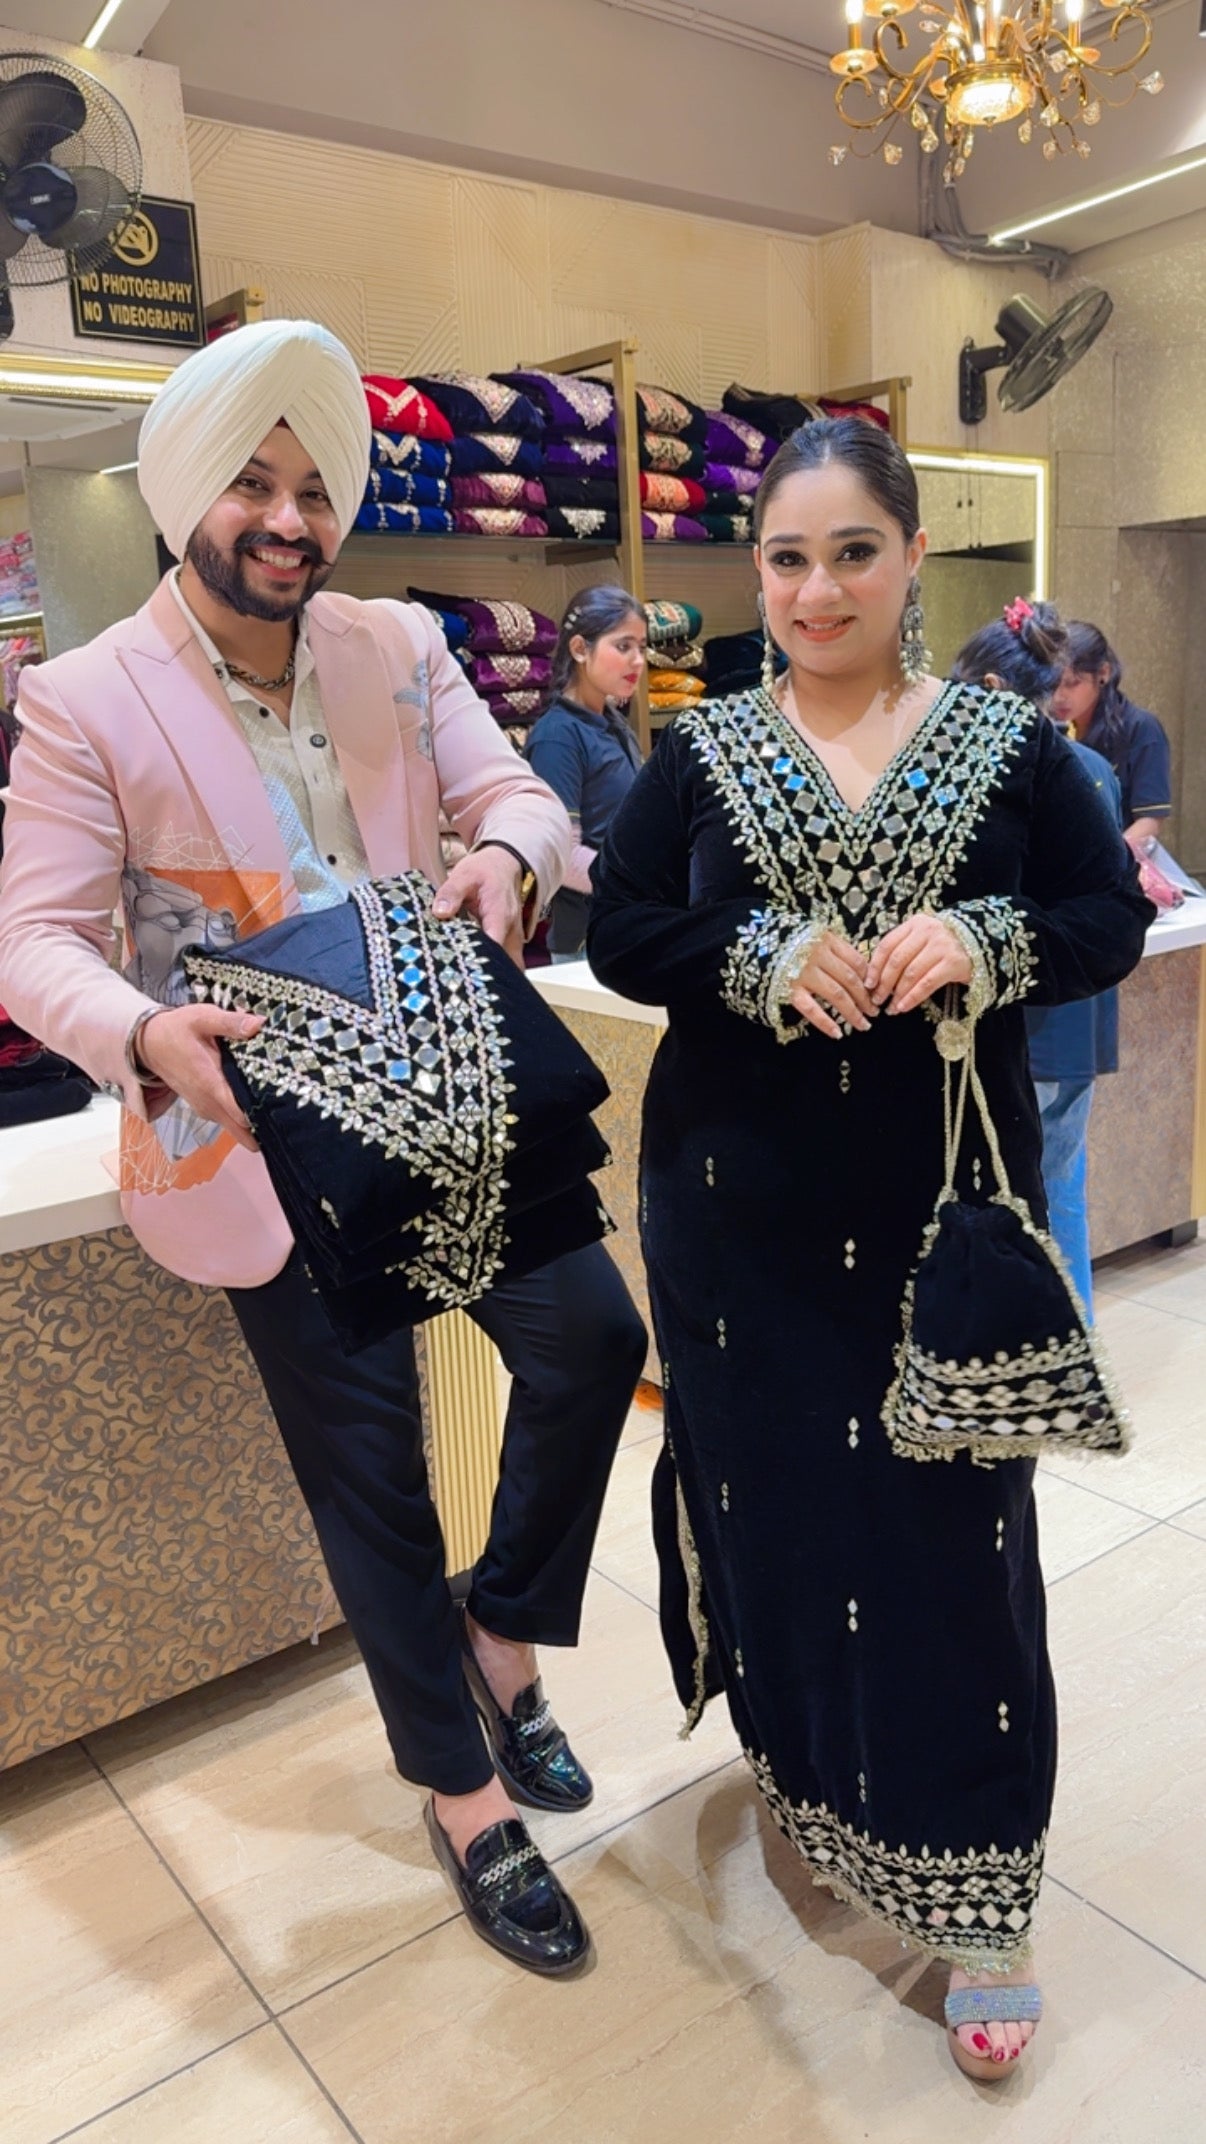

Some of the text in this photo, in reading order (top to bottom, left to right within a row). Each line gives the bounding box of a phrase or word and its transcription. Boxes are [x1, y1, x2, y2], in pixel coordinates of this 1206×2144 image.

[81, 272, 192, 304] NO PHOTOGRAPHY
[83, 301, 195, 332] NO VIDEOGRAPHY
